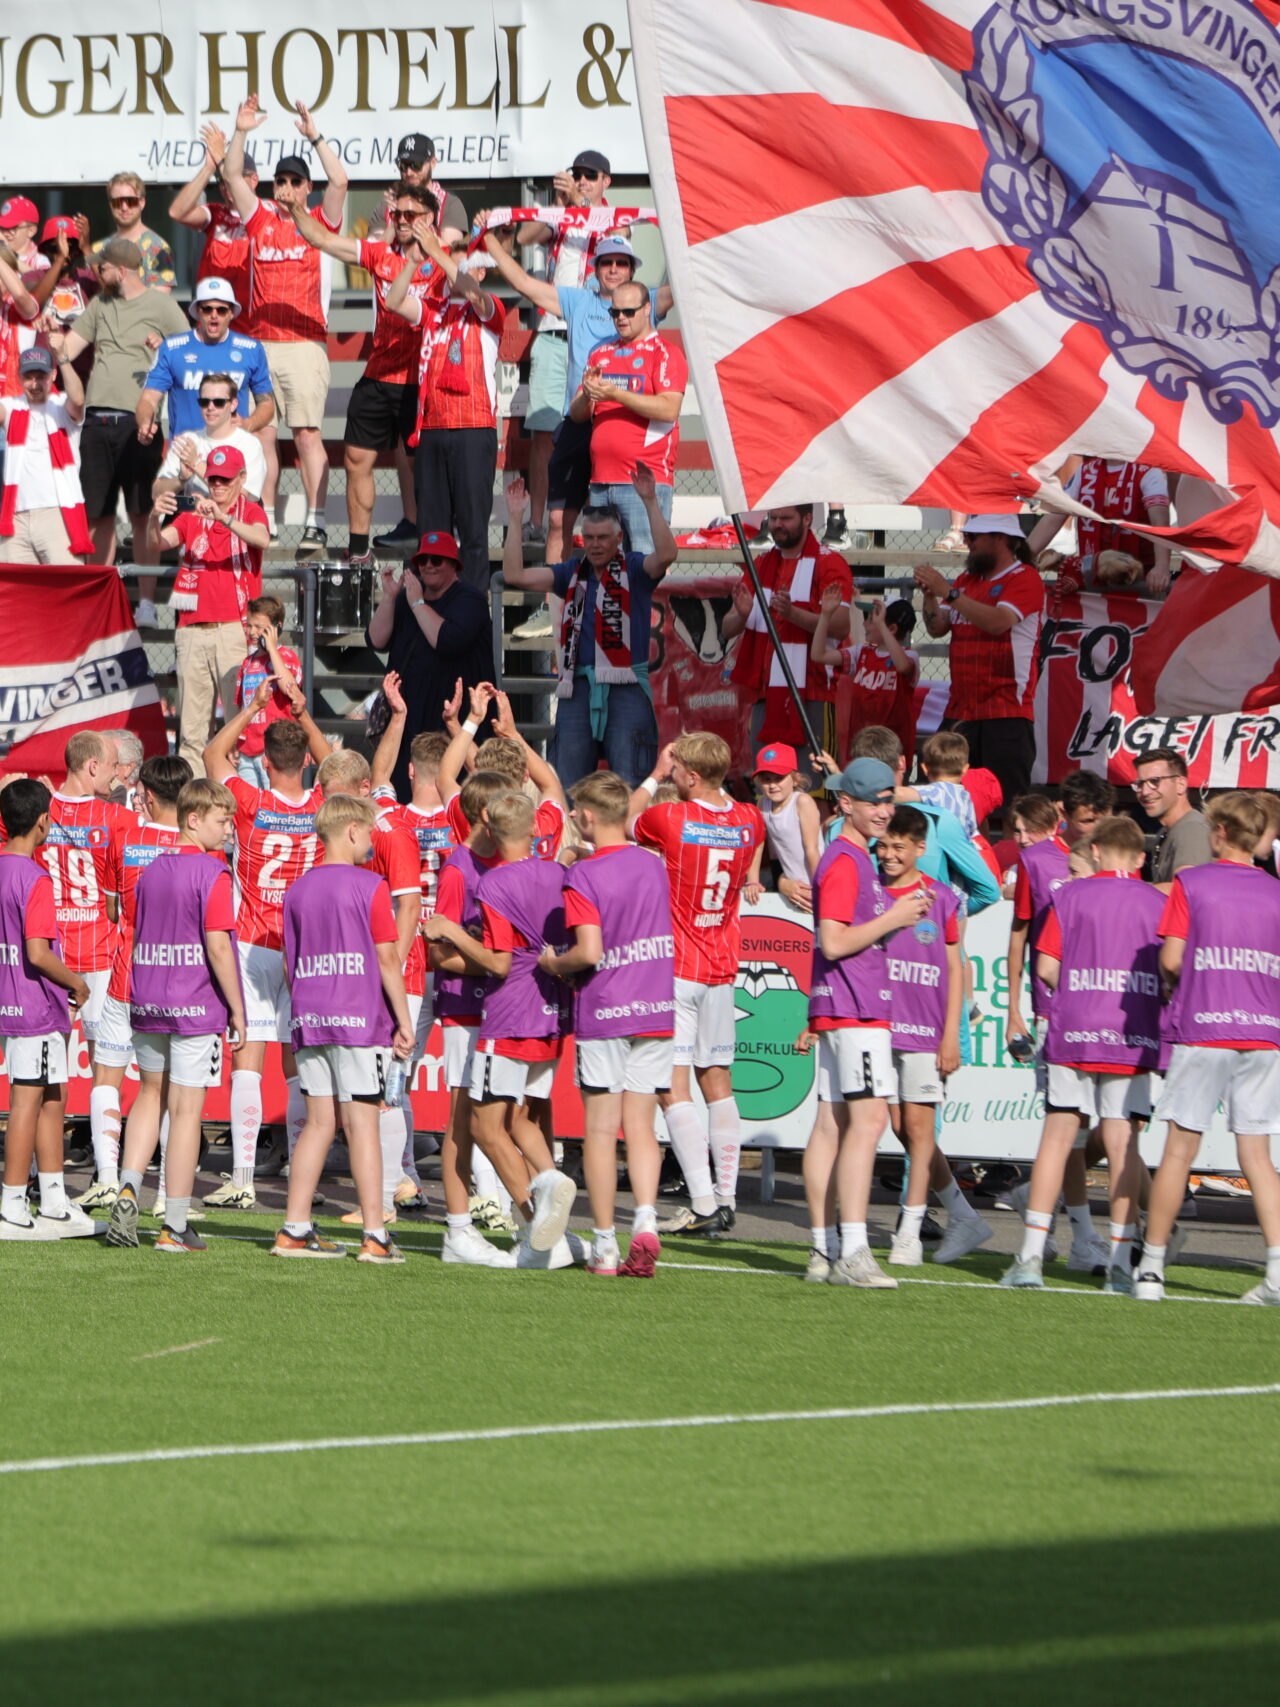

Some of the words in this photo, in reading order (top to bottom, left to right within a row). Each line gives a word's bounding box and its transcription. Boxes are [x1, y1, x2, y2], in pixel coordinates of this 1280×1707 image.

[199, 25, 551, 115] HOTELL
[576, 23, 632, 109] &
[224, 135, 314, 168] LTUR
[329, 135, 362, 165] OG
[370, 134, 510, 166] MGLEDE
[1169, 304, 1246, 345] 189
[1039, 617, 1149, 683] FO
[257, 809, 314, 827] SpareBank
[48, 826, 85, 839] areBank
[125, 846, 164, 858] SpareB
[258, 833, 318, 889] 21
[42, 846, 100, 907] 19
[701, 848, 735, 911] 5
[56, 908, 100, 922] RENDRUP
[133, 944, 204, 966] ALLHENTER
[596, 935, 675, 972] BALLHENTE
[740, 939, 811, 953] SVINGERS
[296, 952, 365, 979] ALLHENTER
[165, 1005, 206, 1017] LIGAEN
[322, 1016, 366, 1028] LIGAEN
[595, 1006, 631, 1020] OBOS
